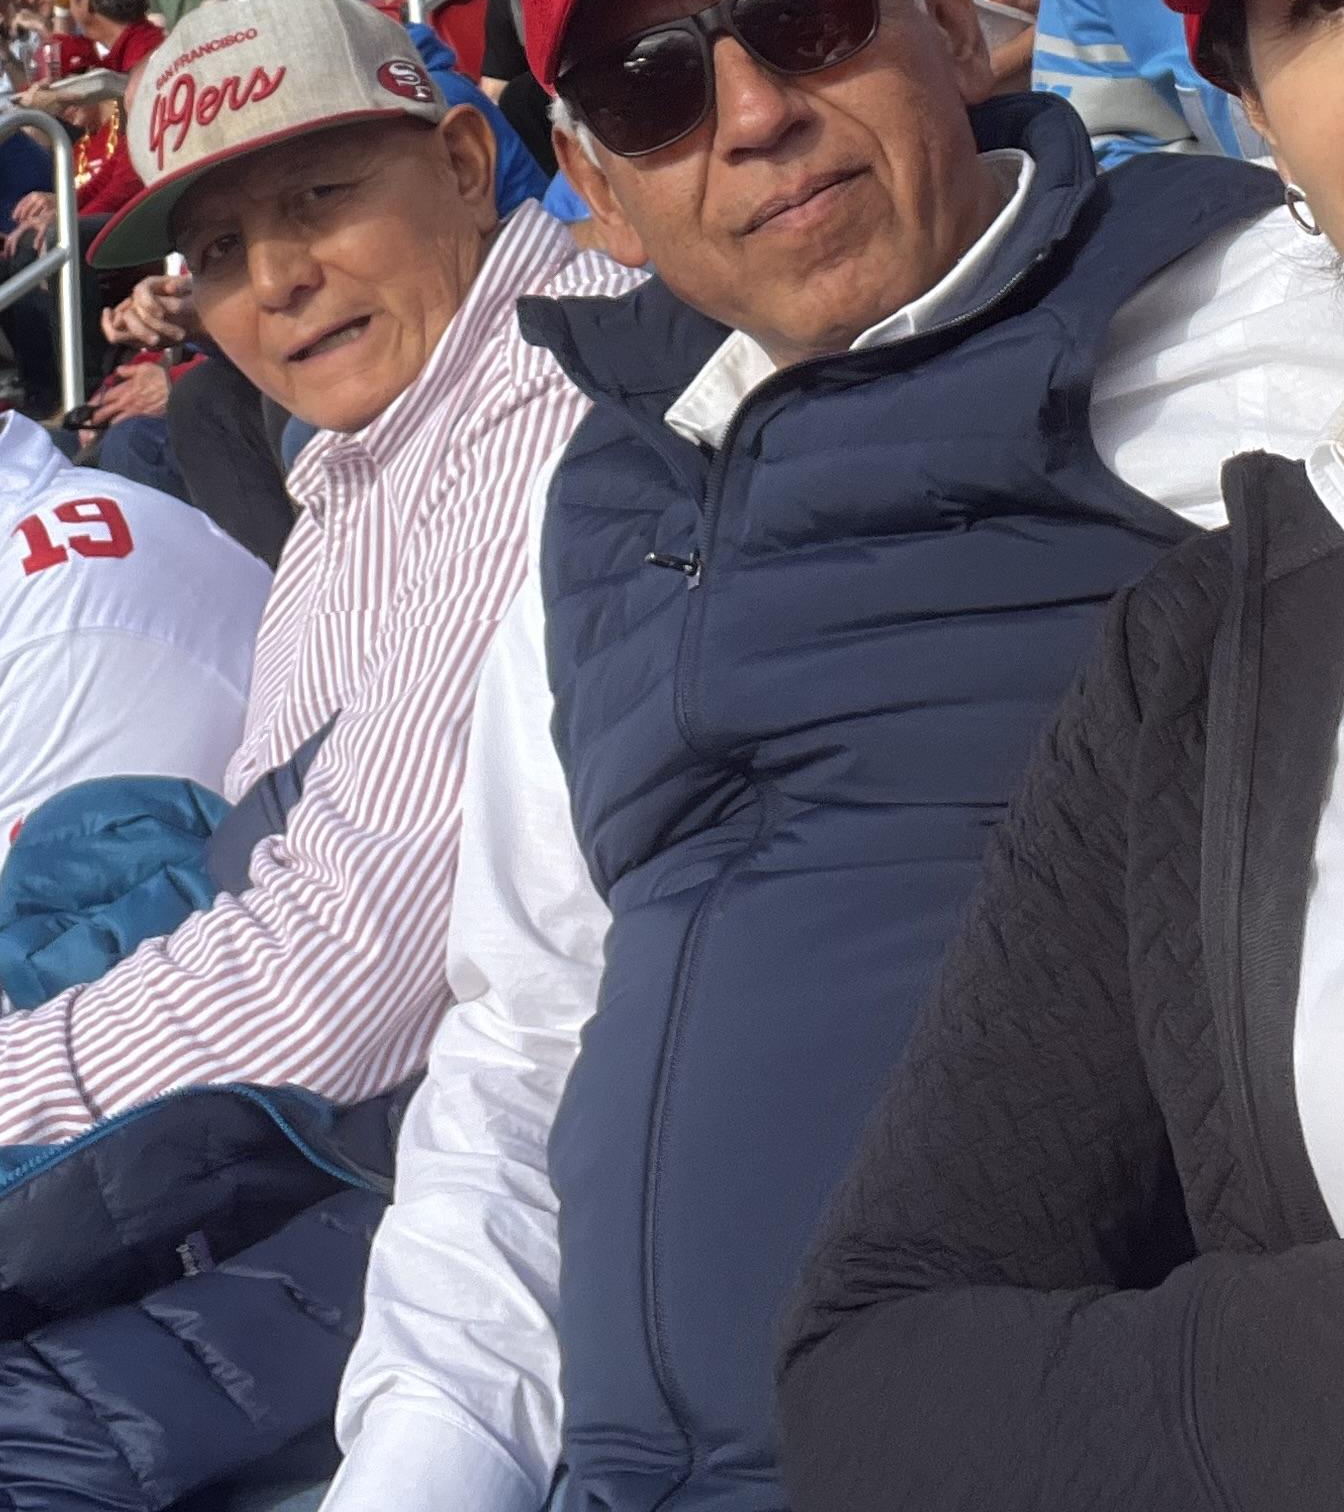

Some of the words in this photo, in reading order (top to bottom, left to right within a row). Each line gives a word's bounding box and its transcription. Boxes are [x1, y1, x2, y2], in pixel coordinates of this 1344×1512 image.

[174, 28, 258, 73] FRANCISCO
[149, 65, 287, 171] 49ers
[10, 495, 135, 577] 19
